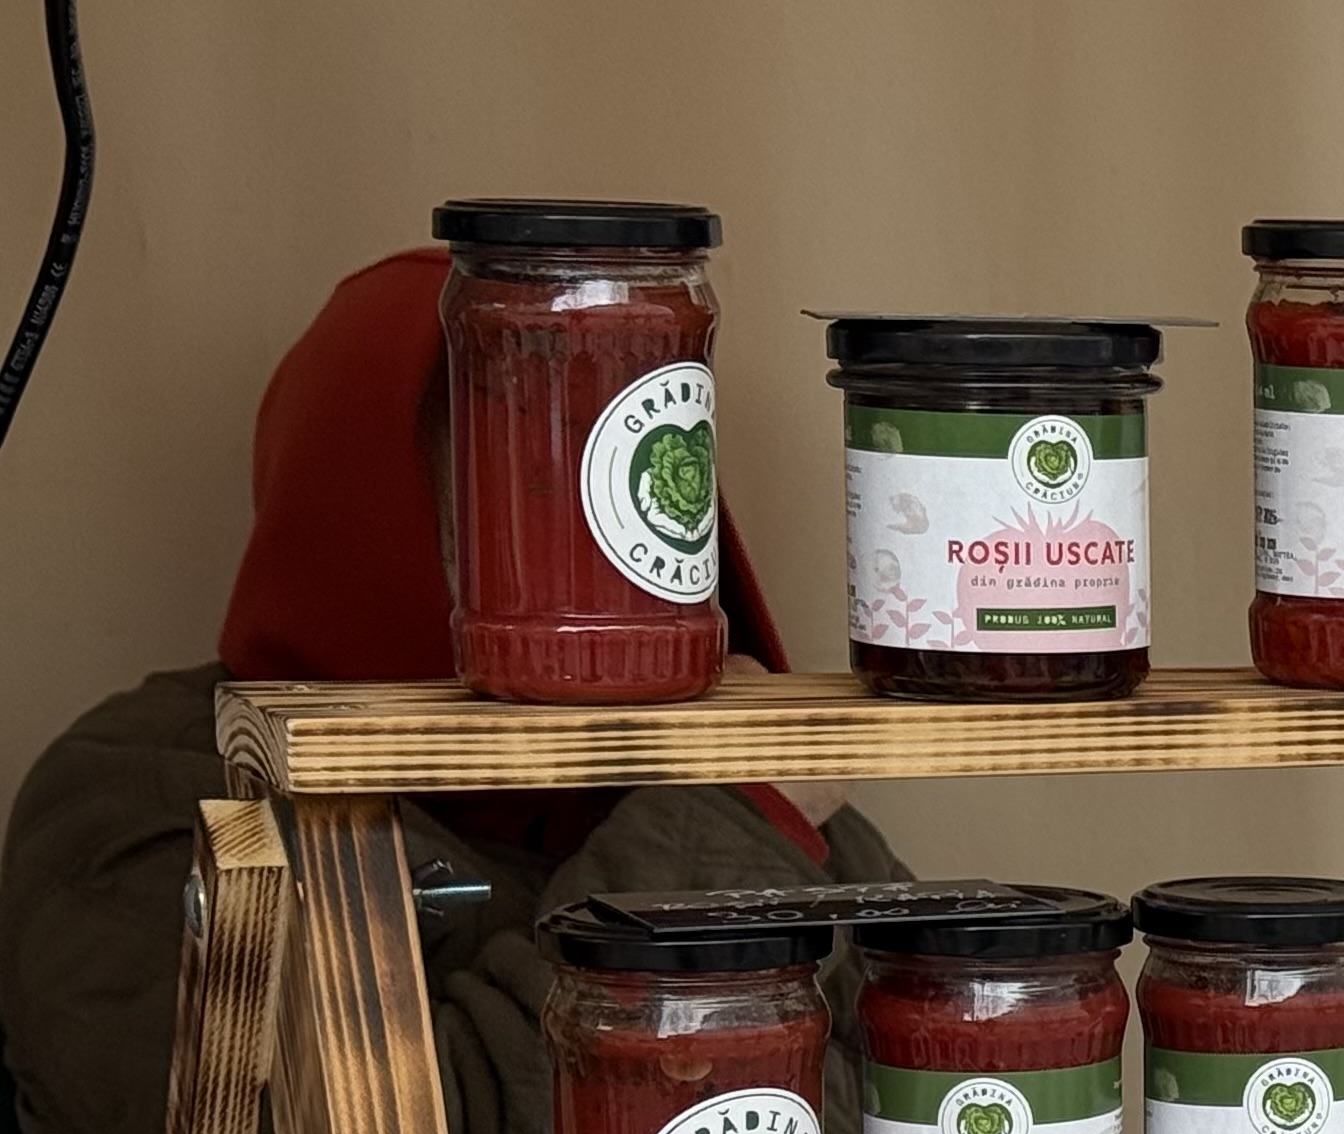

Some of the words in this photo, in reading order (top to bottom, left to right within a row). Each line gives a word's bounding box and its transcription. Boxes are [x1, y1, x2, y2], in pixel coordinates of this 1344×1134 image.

[623, 379, 715, 434] GRĂDIN
[947, 539, 1032, 574] ROȘII
[1045, 539, 1137, 566] USCATE
[970, 575, 997, 588] din
[1006, 574, 1067, 590] grădina
[1073, 575, 1120, 589] proprie
[1036, 613, 1067, 626] 100%
[1071, 611, 1113, 625] NATURAL
